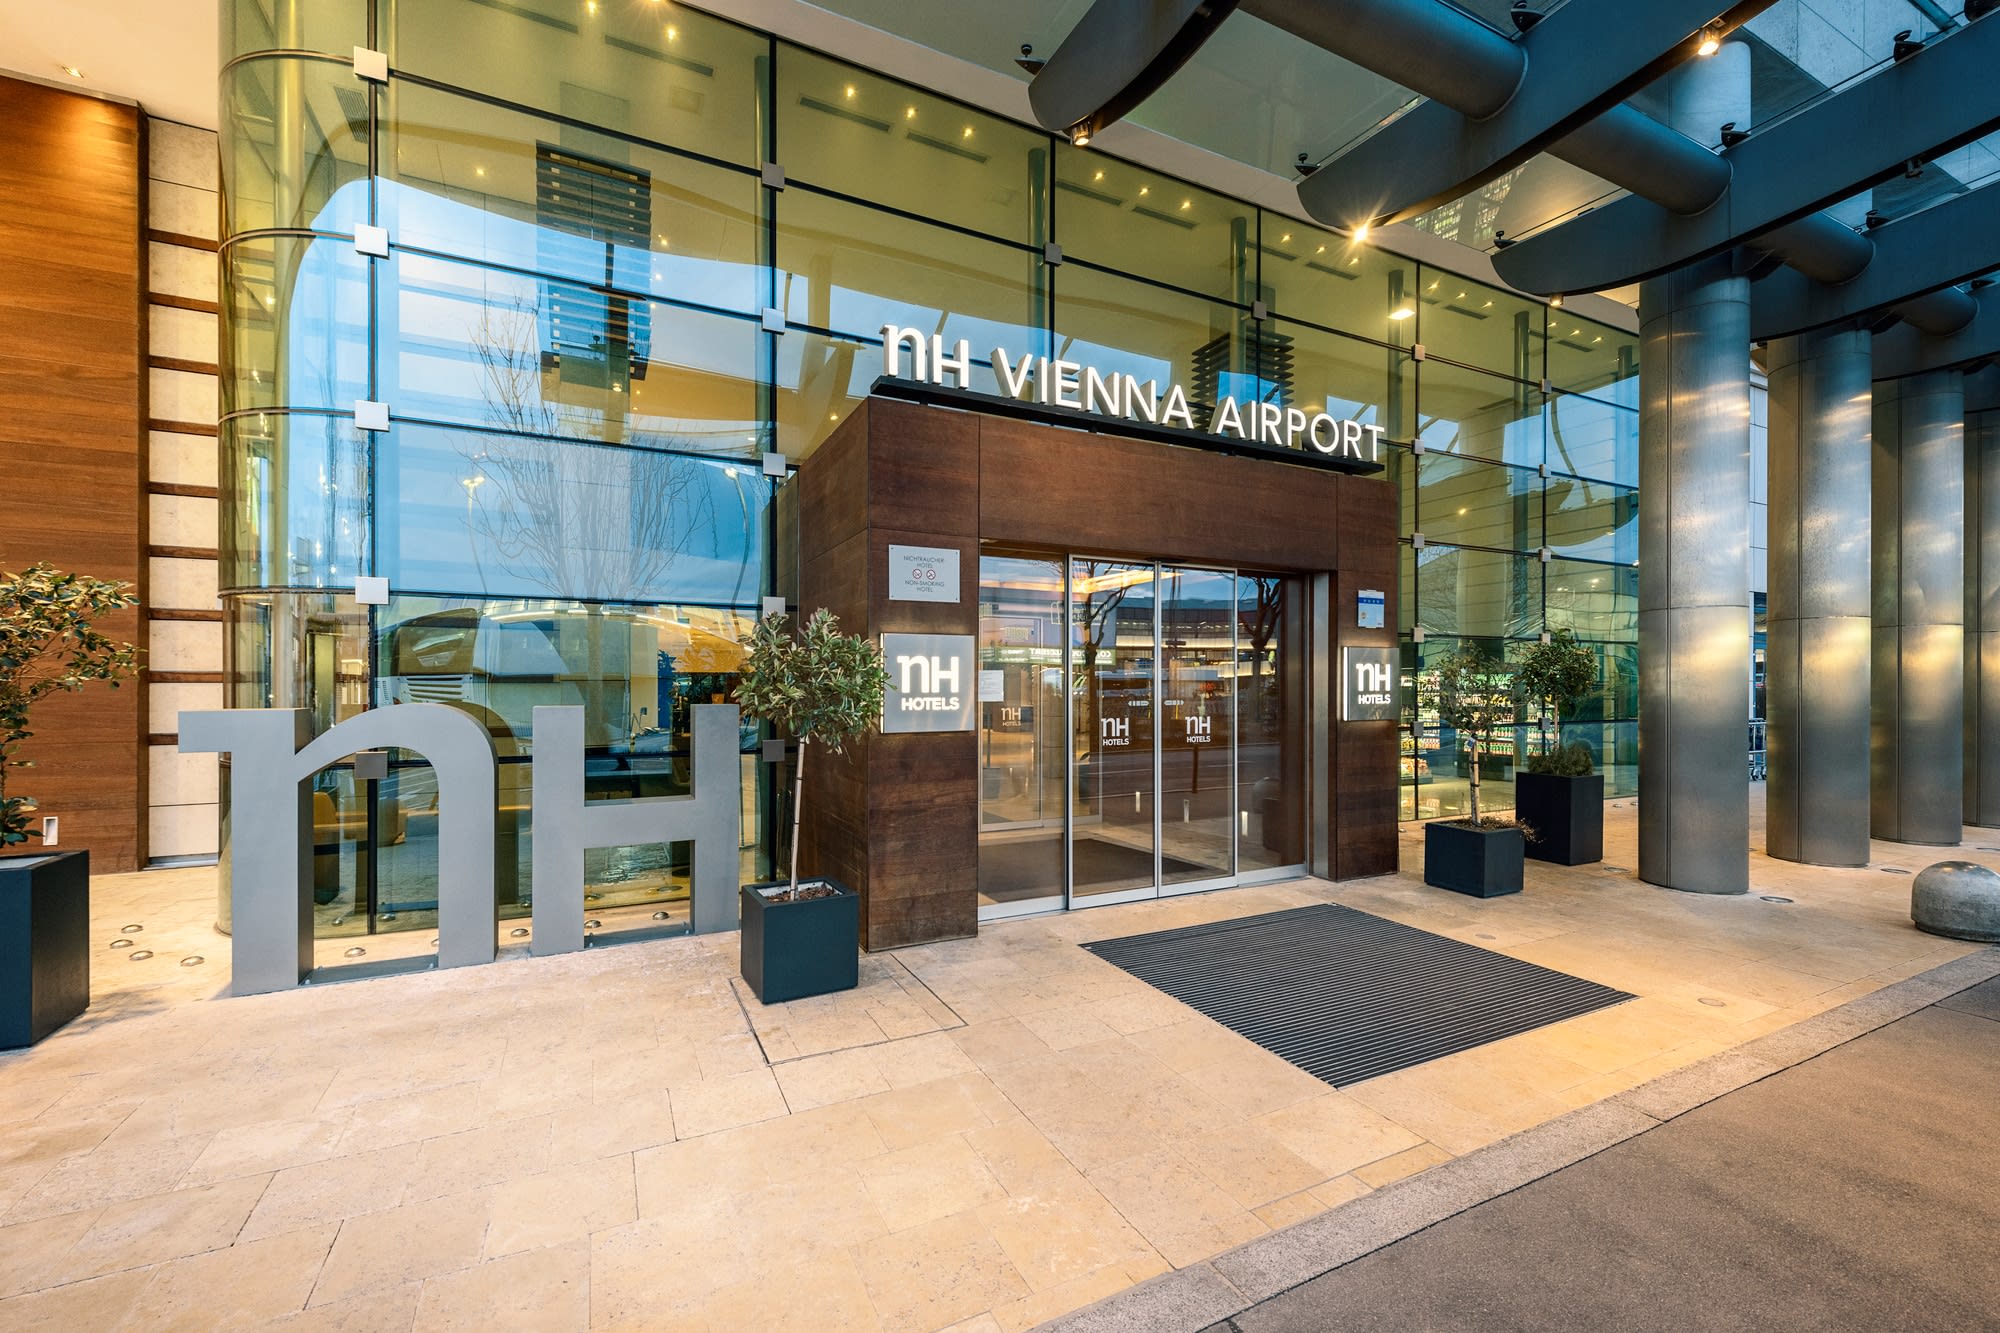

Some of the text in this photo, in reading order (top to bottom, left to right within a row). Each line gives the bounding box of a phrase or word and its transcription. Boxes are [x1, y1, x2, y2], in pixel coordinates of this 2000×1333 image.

[991, 347, 1195, 429] VIENNA
[1208, 396, 1385, 462] AIRPORT
[904, 580, 945, 588] NON-SMOKING
[901, 696, 960, 712] HOTELS
[1358, 693, 1392, 705] HOTELS
[1102, 738, 1130, 746] HOTELS
[1186, 735, 1212, 744] HOTELS
